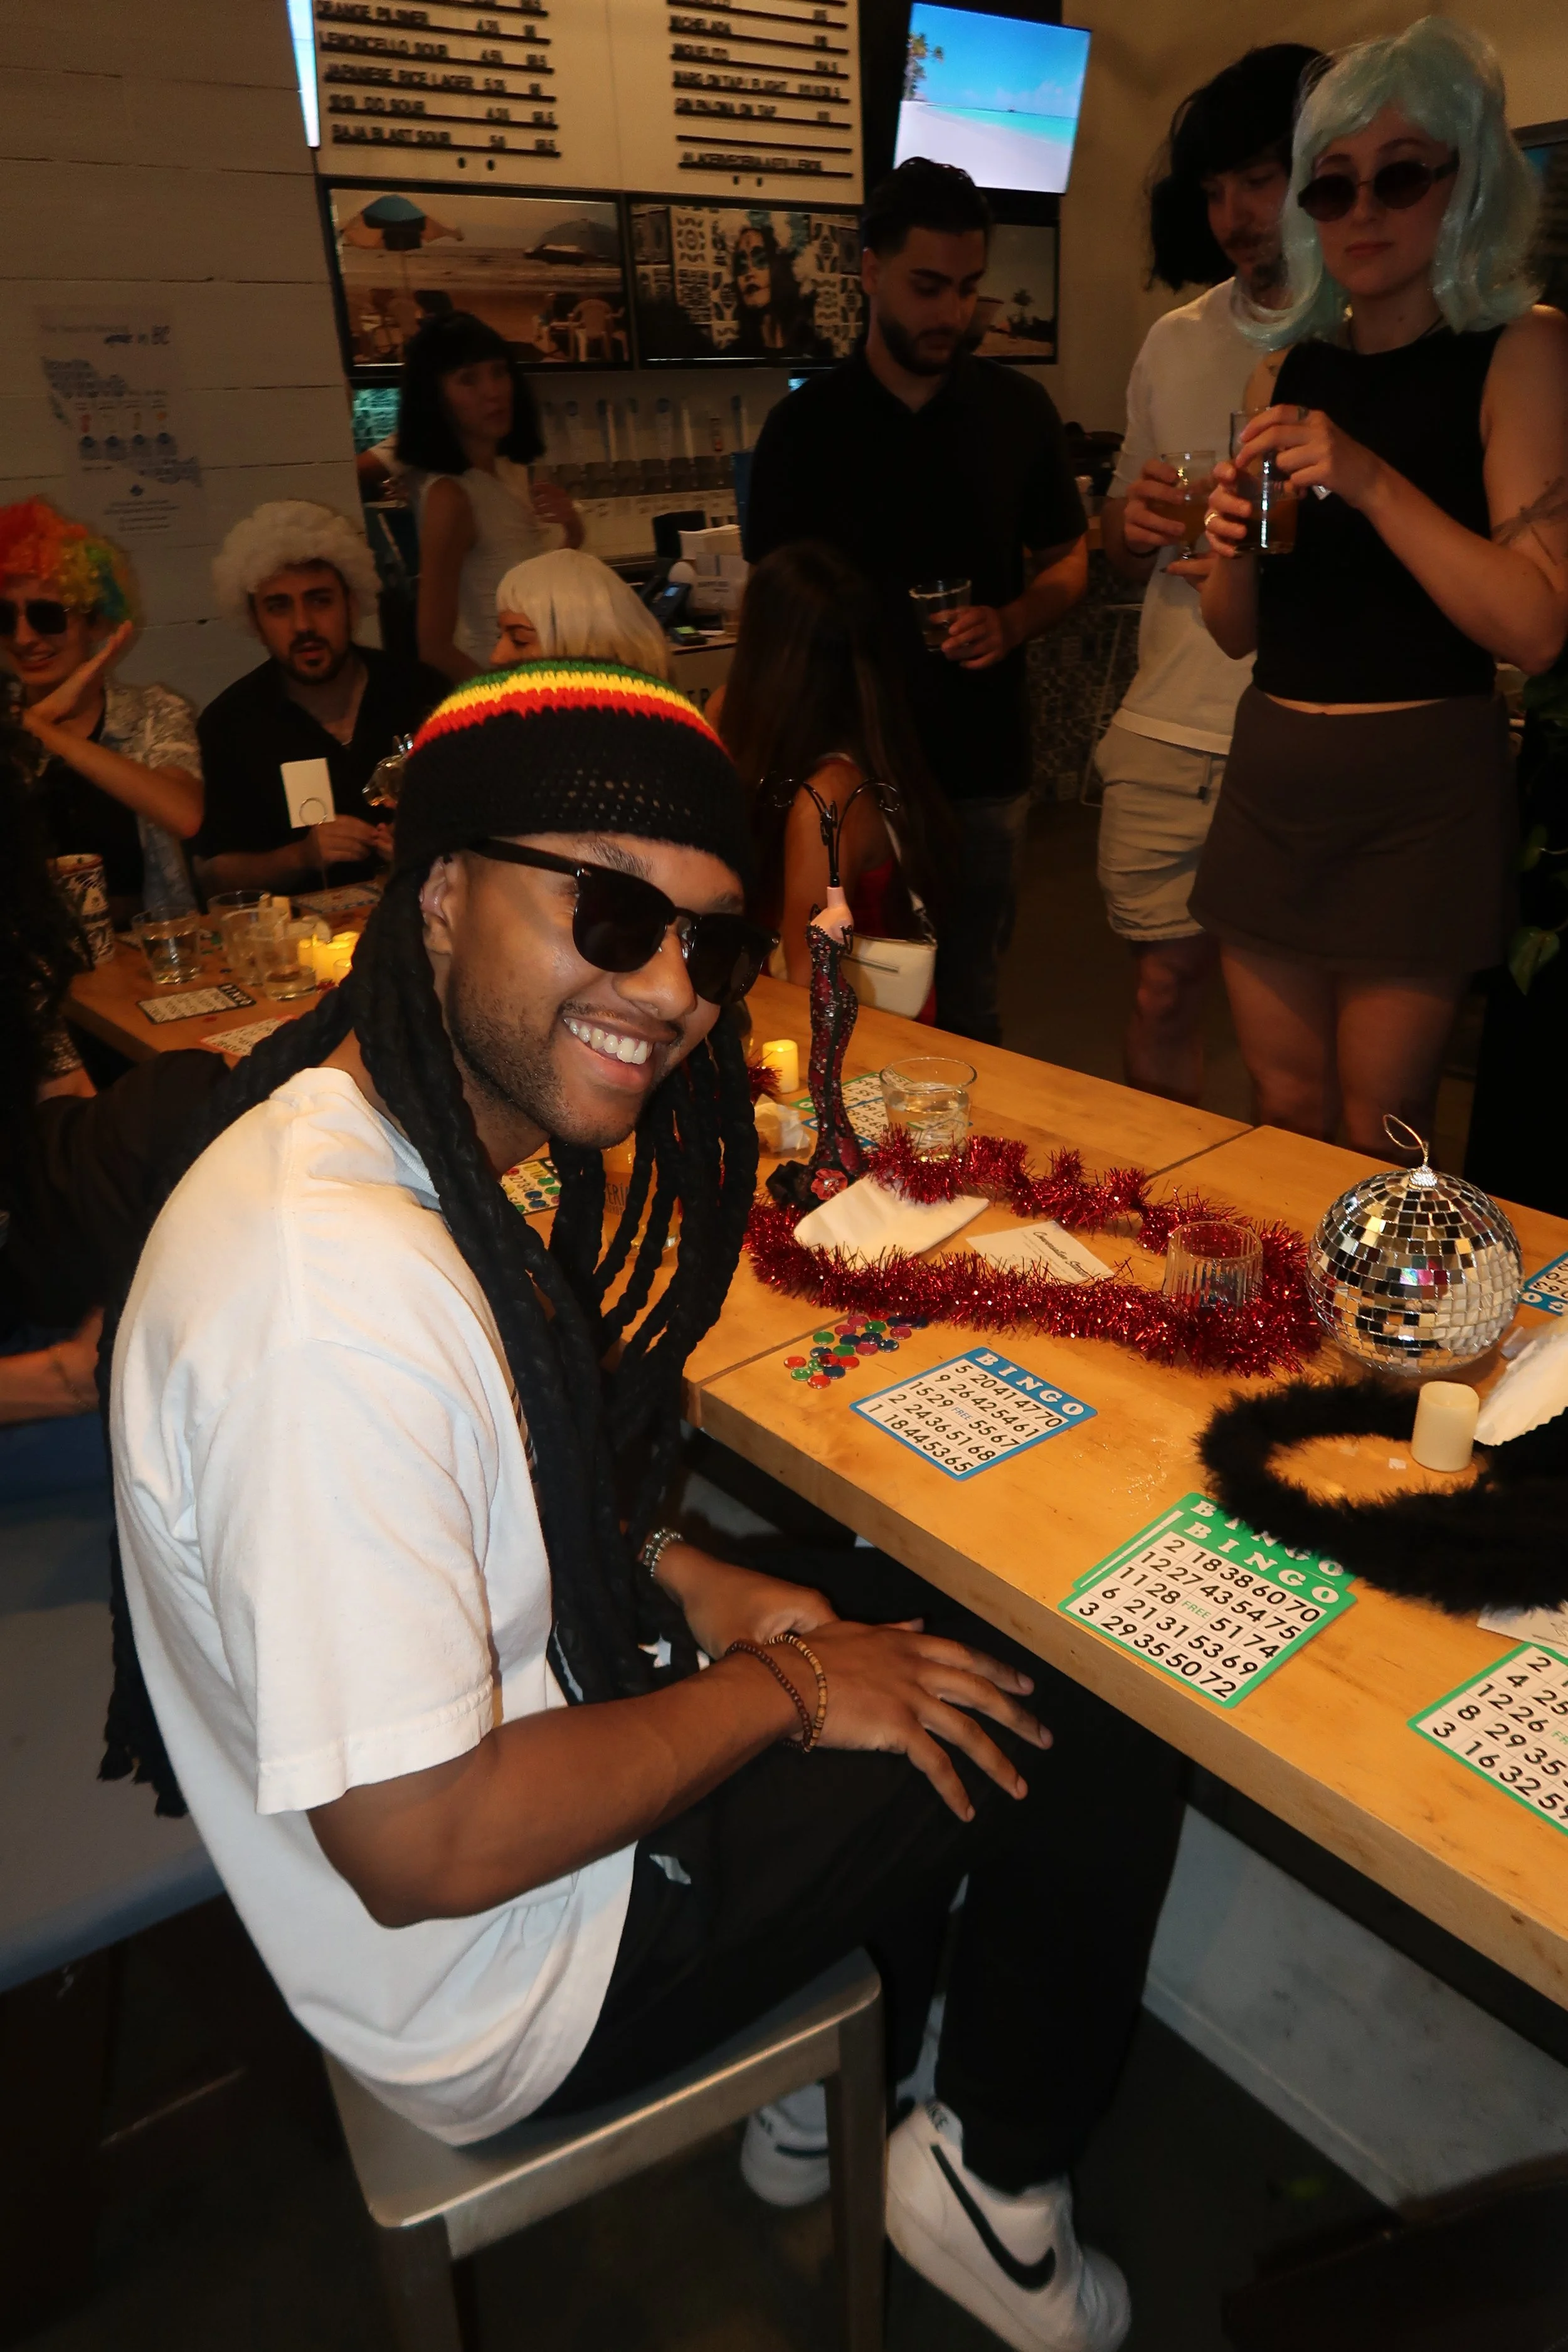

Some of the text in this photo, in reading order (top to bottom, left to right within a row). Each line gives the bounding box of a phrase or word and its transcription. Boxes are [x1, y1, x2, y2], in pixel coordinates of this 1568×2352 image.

[910, 1382, 1020, 1447] 15 29 FREE 55 67
[948, 1384, 975, 1398] 26
[971, 1398, 997, 1412] 42
[990, 1409, 1019, 1425] 54
[1013, 1424, 1039, 1438] 61
[955, 1365, 1063, 1428] 5 20 41 47 70
[975, 1352, 1084, 1416] BINGO
[869, 1404, 974, 1472] 1 18 44 53 65
[888, 1394, 996, 1461] 2 24 36 51 68
[1142, 1551, 1301, 1640] 12 27 43 54 75
[1164, 1540, 1320, 1622] 2 18 38 60 70
[1184, 1521, 1340, 1604] BINGO
[1101, 1587, 1258, 1675] 6 21 31 53 69
[1120, 1567, 1280, 1659] 11 28 FREE 51 74
[1079, 1602, 1236, 1698] 3 29 35 50 72
[1527, 1657, 1552, 1673] 2
[1478, 1684, 1513, 1710] 12
[1508, 1706, 1549, 1732] 26
[1506, 1675, 1568, 1715] 4 25
[1433, 1722, 1456, 1738] 3
[1465, 1740, 1500, 1769] 16
[1498, 1766, 1541, 1797] 32
[1457, 1705, 1567, 1776] 8 29 35
